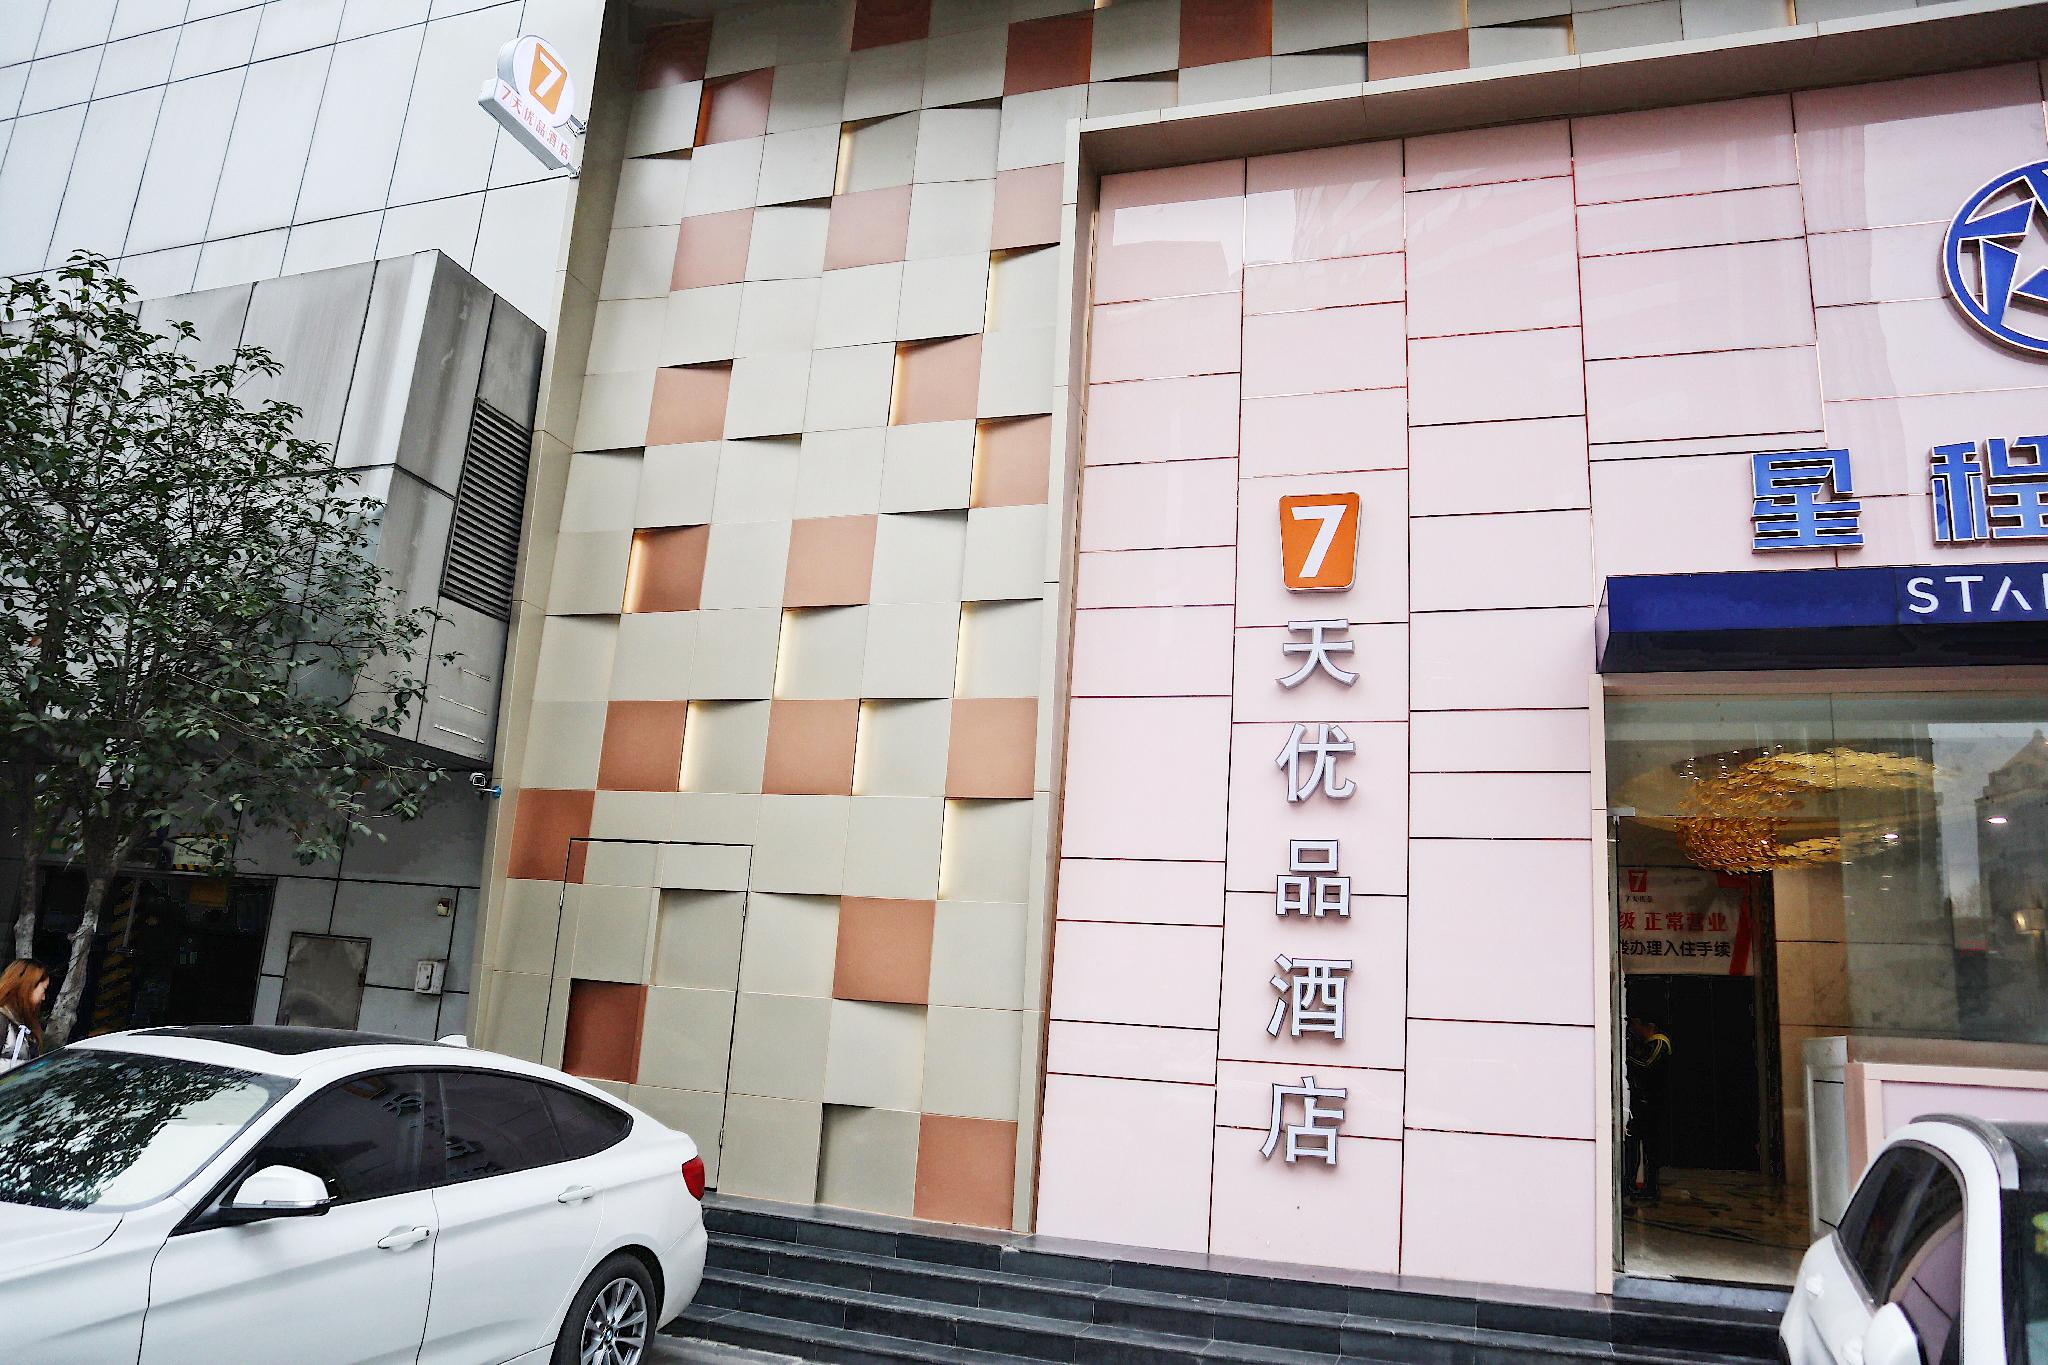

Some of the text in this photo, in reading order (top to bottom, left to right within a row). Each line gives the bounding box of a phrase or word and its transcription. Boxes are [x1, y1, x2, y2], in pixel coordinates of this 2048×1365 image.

[535, 51, 563, 98] 7
[501, 85, 569, 160] 7天优品酒店
[1750, 436, 2048, 553] 星程
[1906, 572, 2048, 614] STA
[1645, 912, 1728, 932] 正常营业
